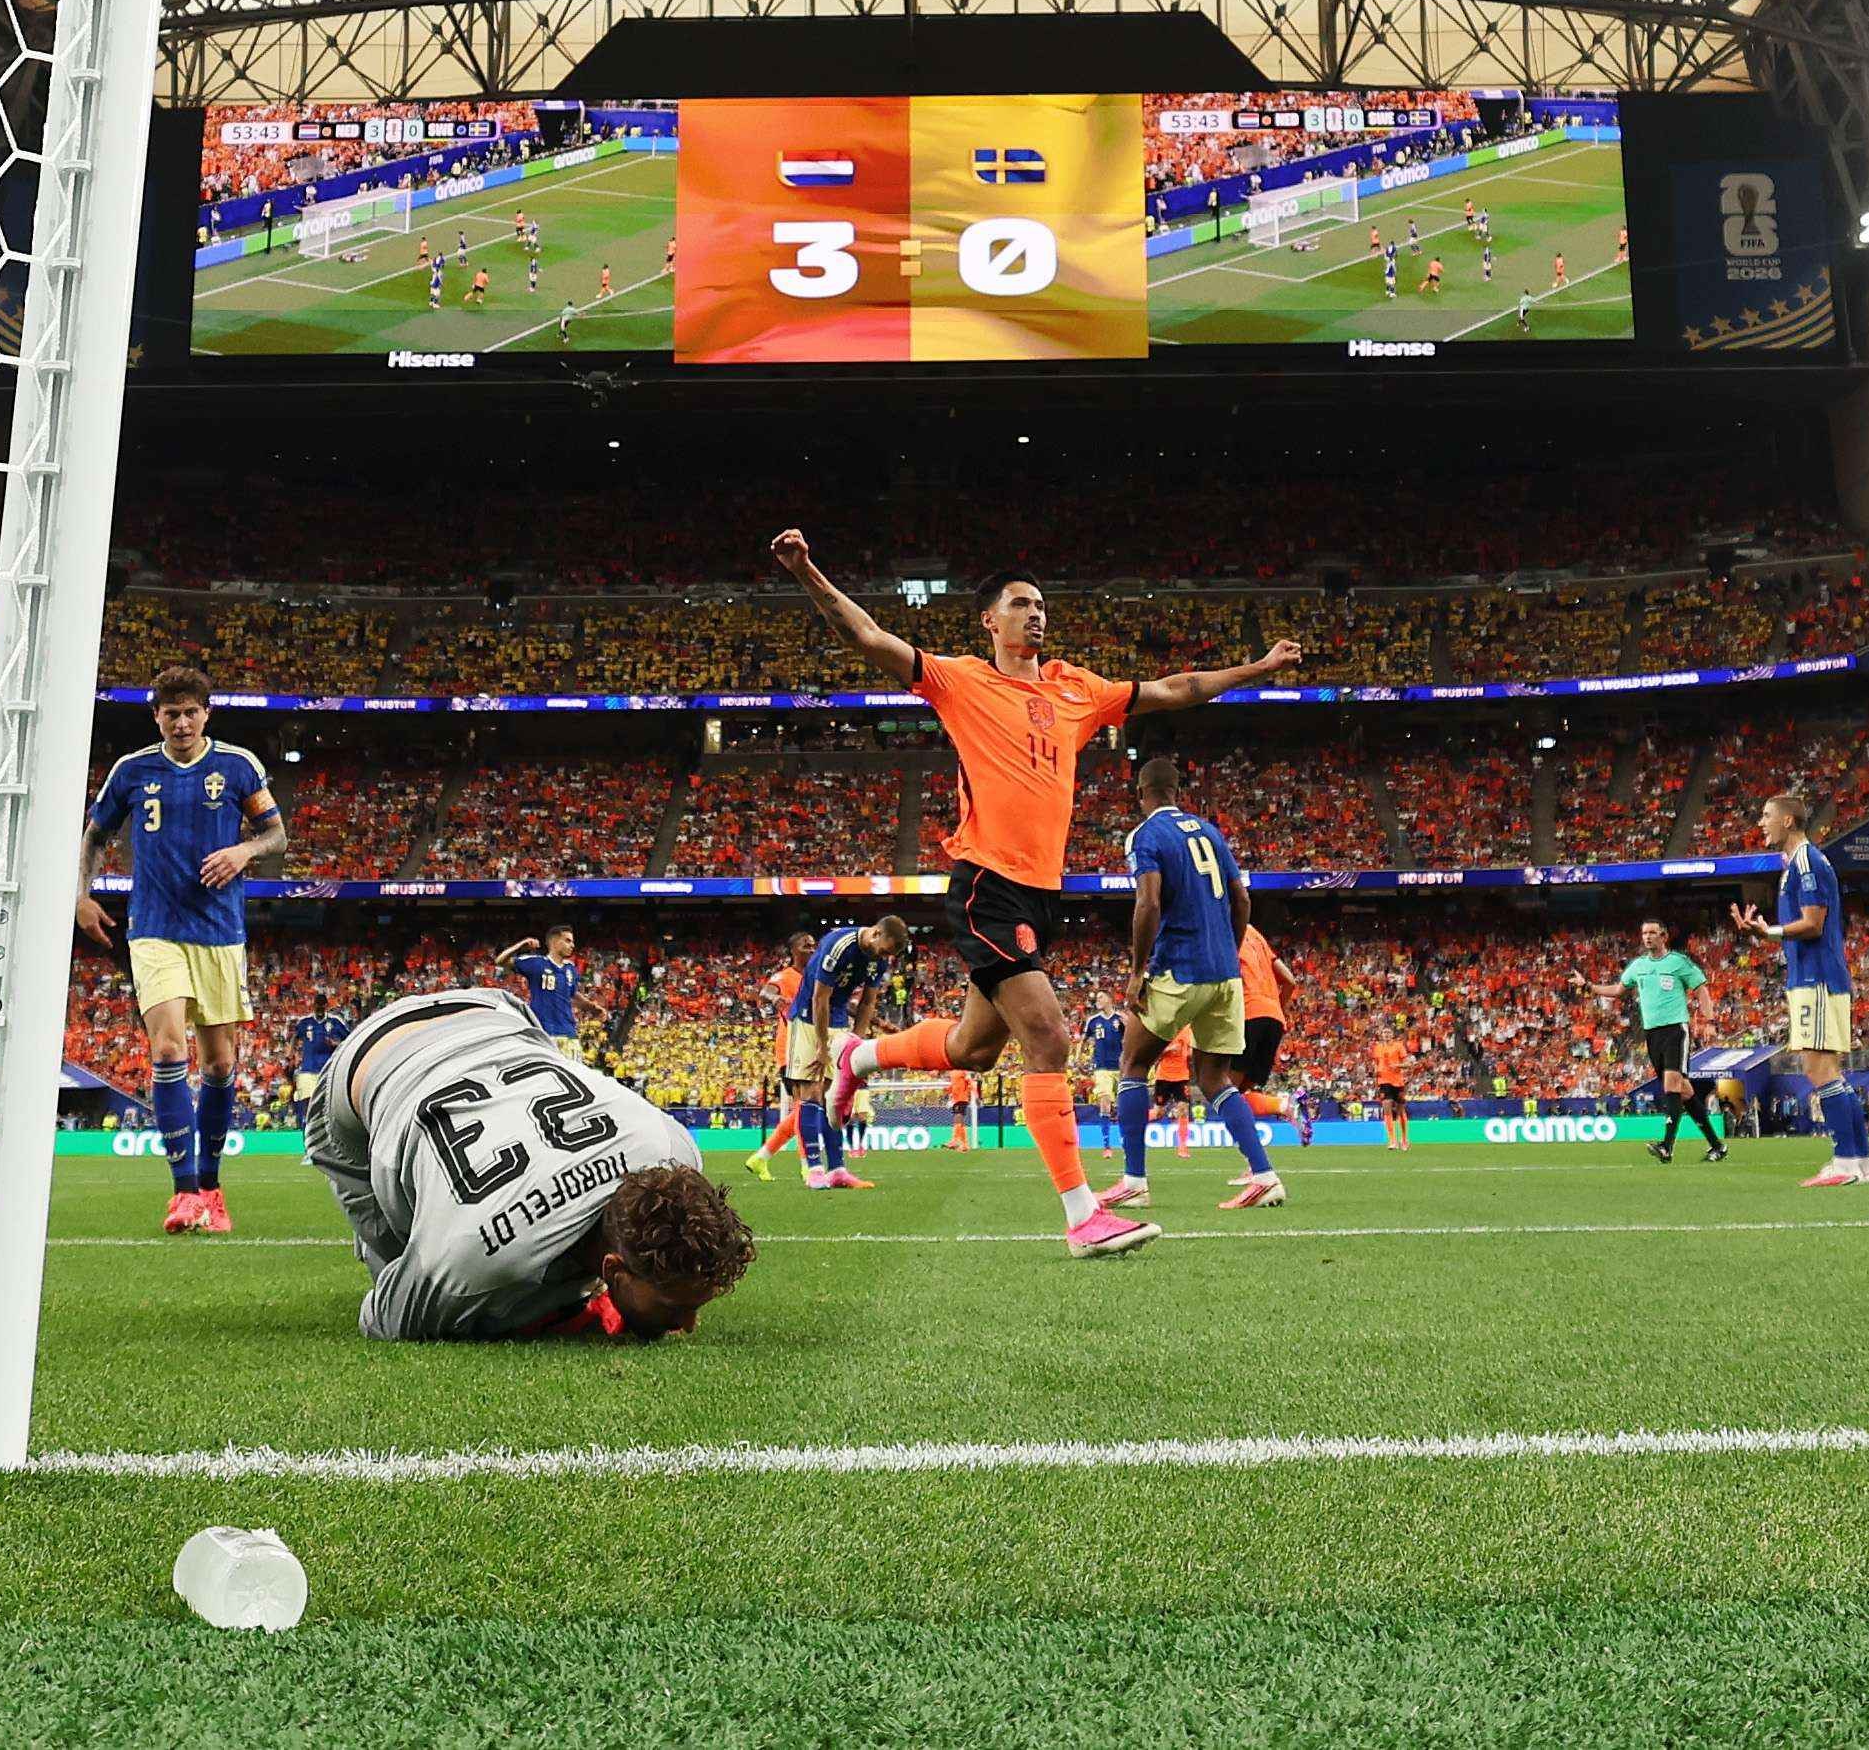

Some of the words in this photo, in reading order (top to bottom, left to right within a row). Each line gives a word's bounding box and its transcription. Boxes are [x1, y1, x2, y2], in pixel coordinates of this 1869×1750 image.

[232, 126, 280, 139] 53:43
[1172, 115, 1219, 128] 53:43
[1740, 238, 1766, 249] FIFA
[768, 221, 860, 298] 3
[958, 217, 1058, 297] 0
[387, 351, 475, 368] Hisense
[1348, 340, 1436, 357] Hisense
[1027, 731, 1058, 775] 14
[143, 798, 162, 832] 3
[1187, 836, 1225, 900] 4
[415, 1060, 619, 1208] 23
[1484, 1116, 1617, 1143] aramco
